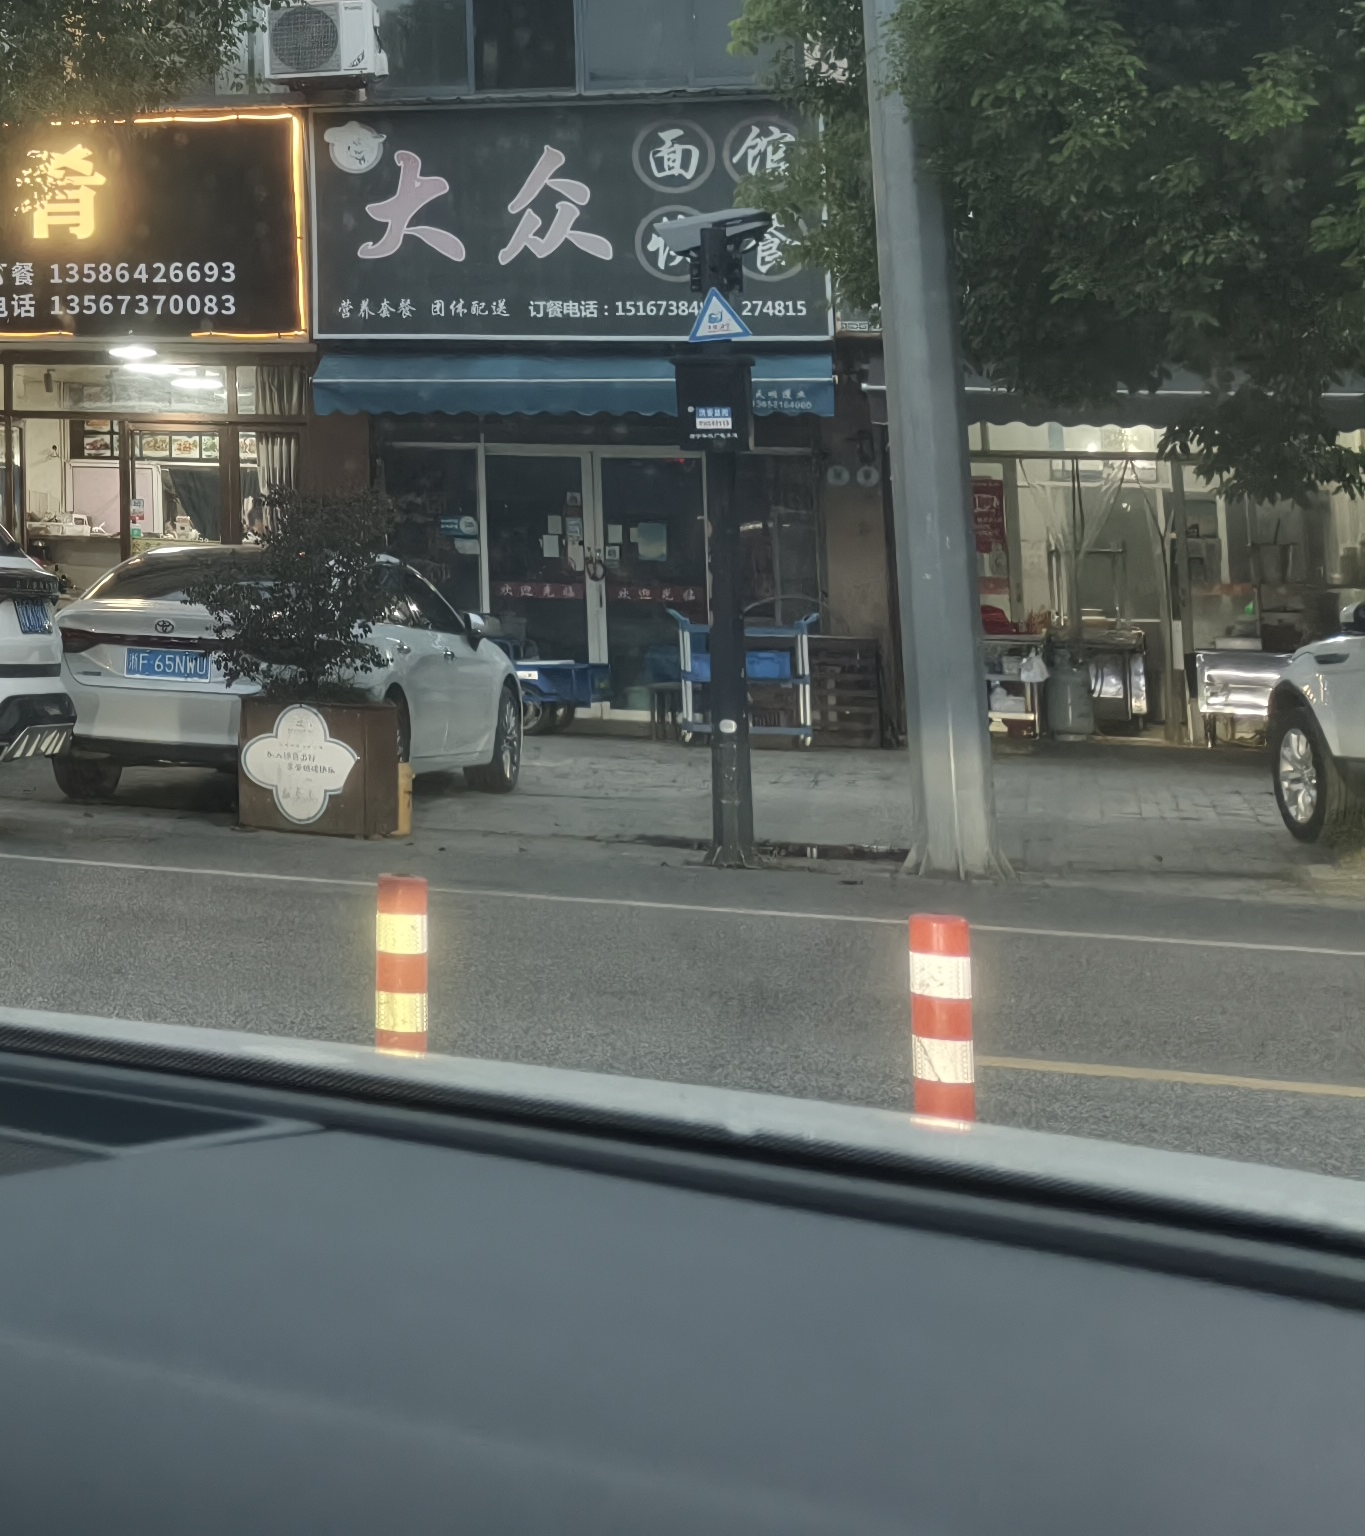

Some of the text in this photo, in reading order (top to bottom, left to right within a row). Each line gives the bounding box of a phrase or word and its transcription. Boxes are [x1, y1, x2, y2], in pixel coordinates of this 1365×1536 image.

[357, 144, 614, 266] 大众
[49, 261, 236, 284] 13586426693
[50, 295, 236, 315] 13567370083
[338, 298, 418, 318] 营养套餐
[430, 298, 512, 318] 团体配送
[741, 300, 807, 317] 274815
